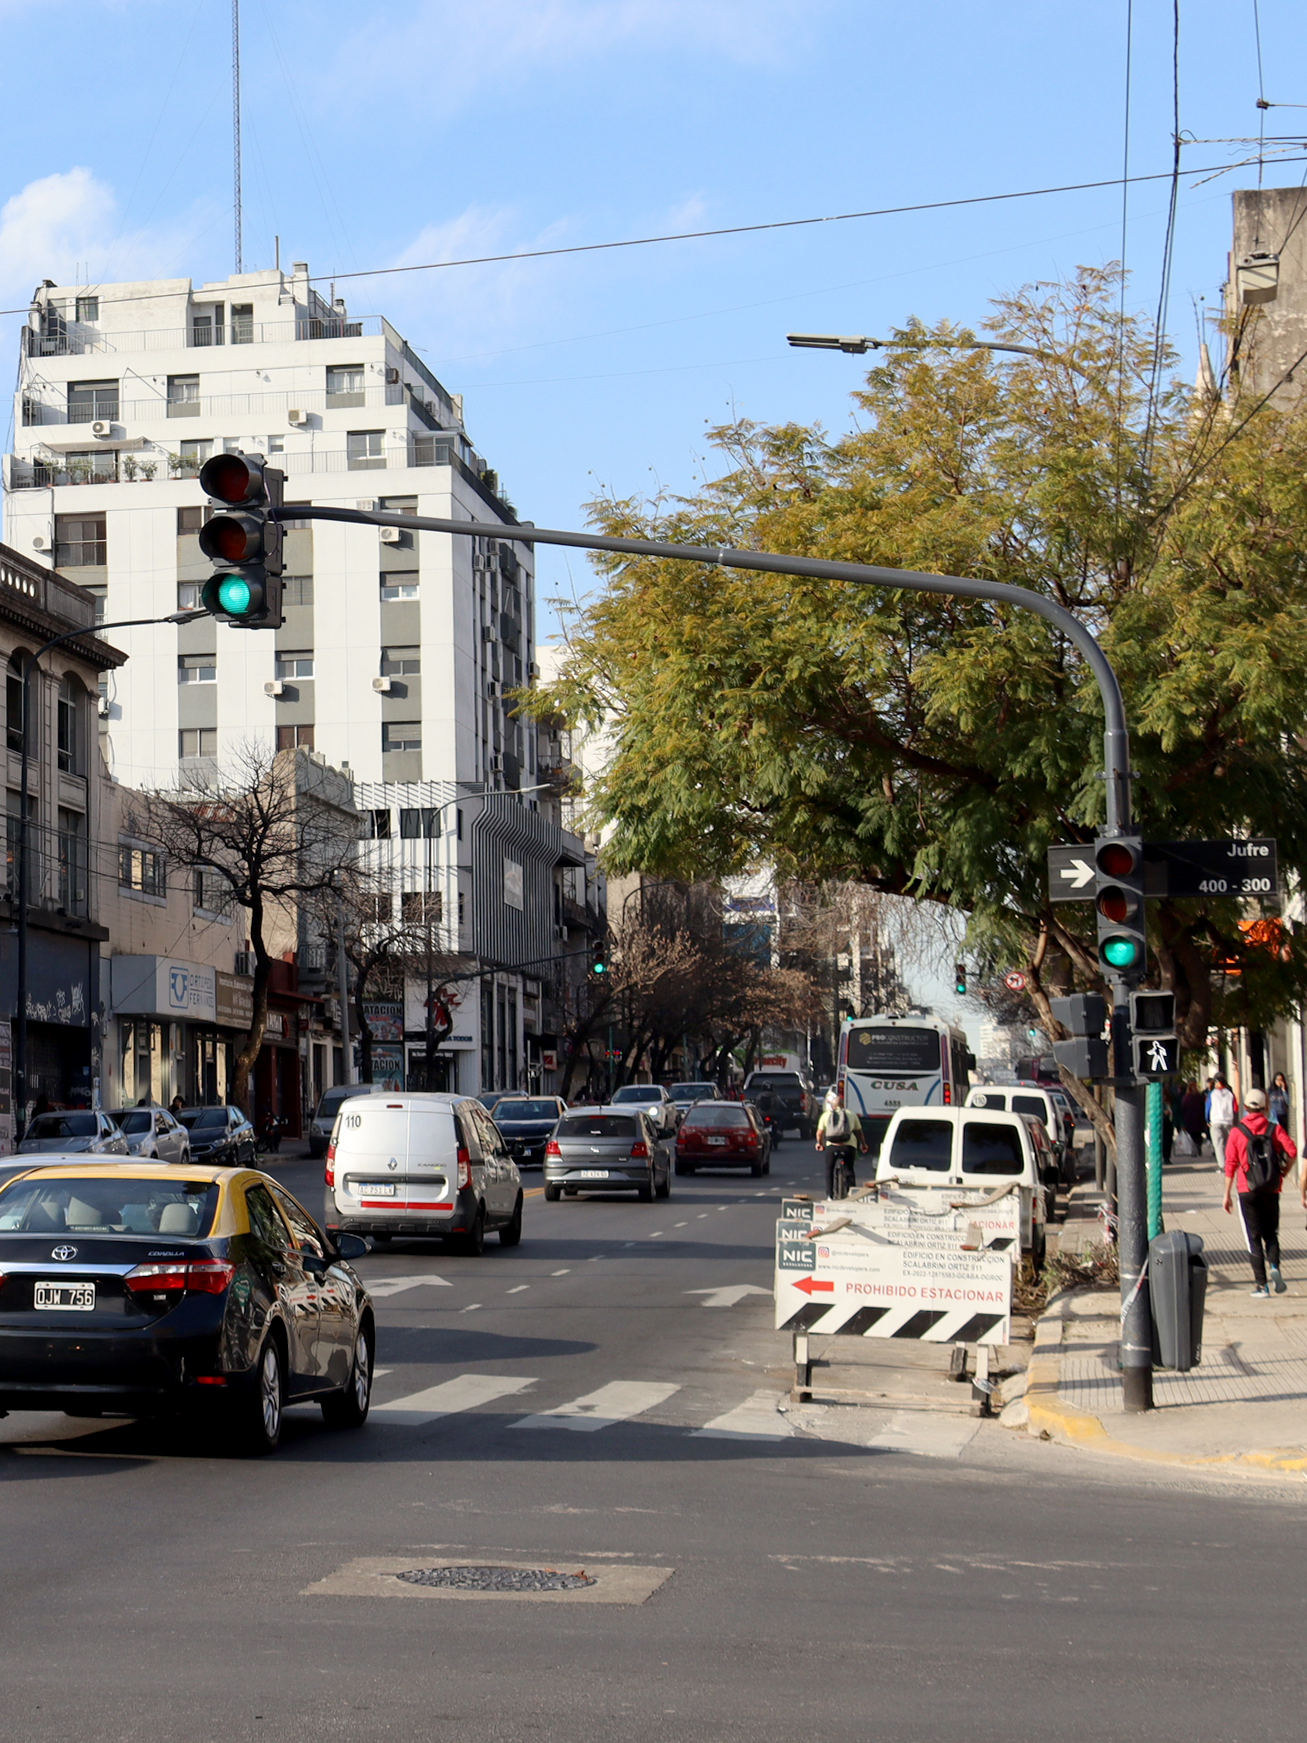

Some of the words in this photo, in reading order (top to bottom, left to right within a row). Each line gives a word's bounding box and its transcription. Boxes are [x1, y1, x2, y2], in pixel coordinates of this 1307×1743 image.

[1226, 843, 1269, 857] Jufre
[1199, 879, 1227, 892] 400
[1241, 877, 1271, 892] 300
[364, 1005, 402, 1015] ATACION
[371, 1060, 400, 1071] TACION
[871, 1081, 919, 1091] CUSA
[345, 1115, 361, 1128] 110
[369, 1185, 382, 1195] 751
[786, 1207, 812, 1218] NIC
[970, 1220, 1015, 1230] ACIONAR
[887, 1231, 915, 1239] EDIFICIO
[926, 1234, 966, 1242] CONSTRUCC
[888, 1240, 925, 1248] SCALABRINI
[927, 1241, 946, 1249] ORTIZ
[783, 1248, 813, 1263] NIC
[903, 1251, 933, 1260] EDIFICIO
[903, 1261, 946, 1270] SCALABRINI
[948, 1262, 970, 1271] ORTIZ
[37, 1289, 62, 1305] OJW
[68, 1290, 93, 1305] 756
[845, 1282, 917, 1297] PROHIBIDO
[921, 1287, 1004, 1303] ESTACIONAR
